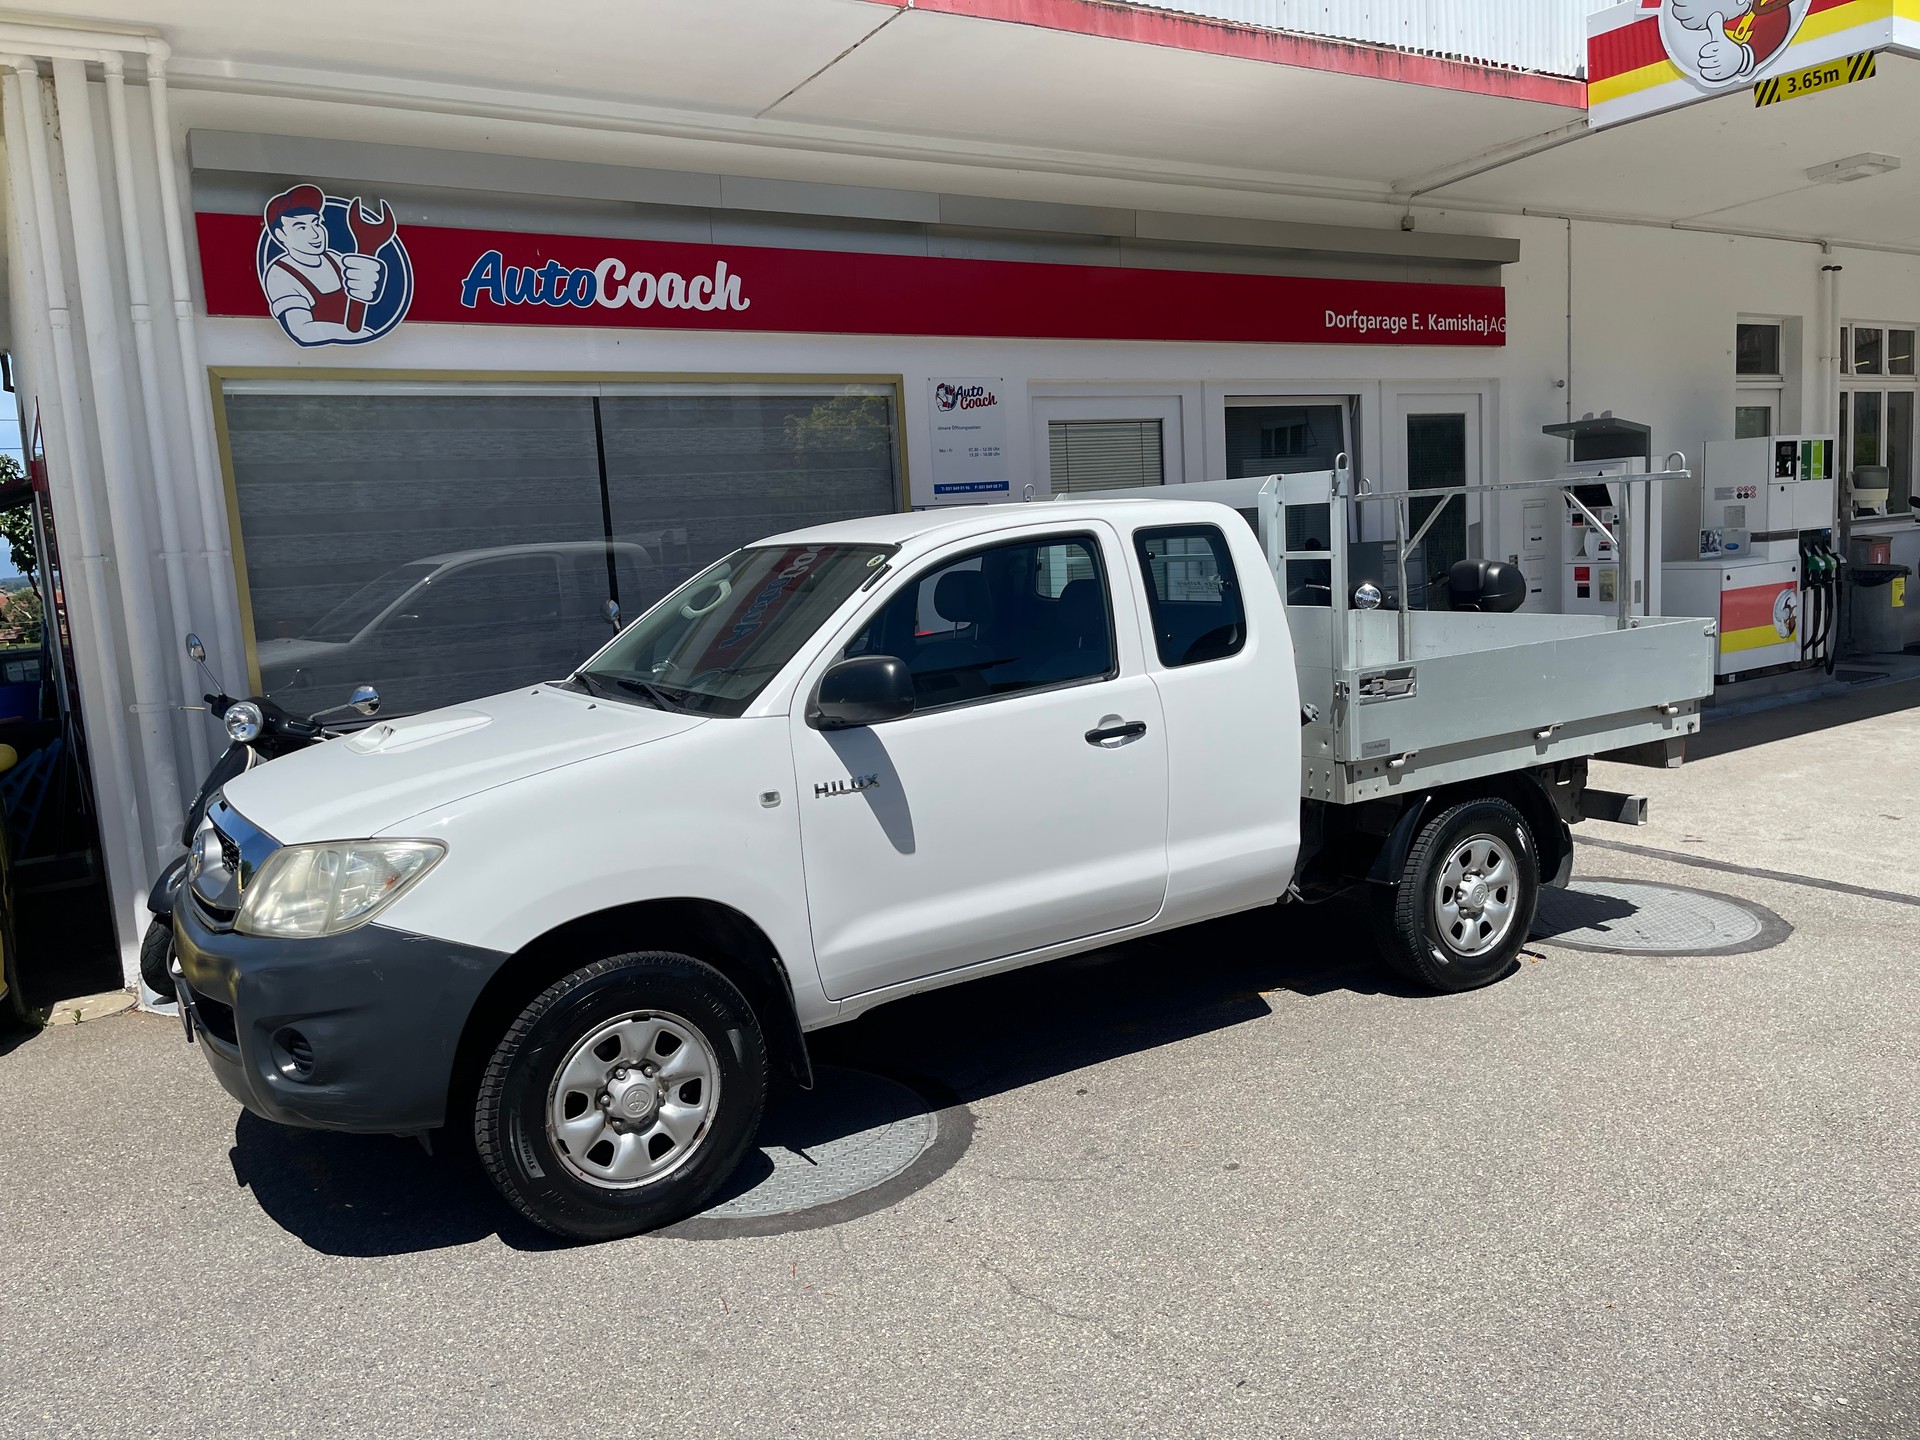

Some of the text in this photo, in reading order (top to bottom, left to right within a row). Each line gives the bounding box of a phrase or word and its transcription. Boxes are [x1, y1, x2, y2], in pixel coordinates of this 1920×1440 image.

[1787, 68, 1840, 93] 3.65m
[460, 249, 750, 312] AutoCoach
[1325, 310, 1408, 334] Dorfgarage
[1412, 313, 1424, 330] E.
[955, 386, 984, 400] Auto
[960, 392, 998, 410] Coach
[1786, 461, 1792, 474] 1
[814, 773, 881, 799] HILUX
